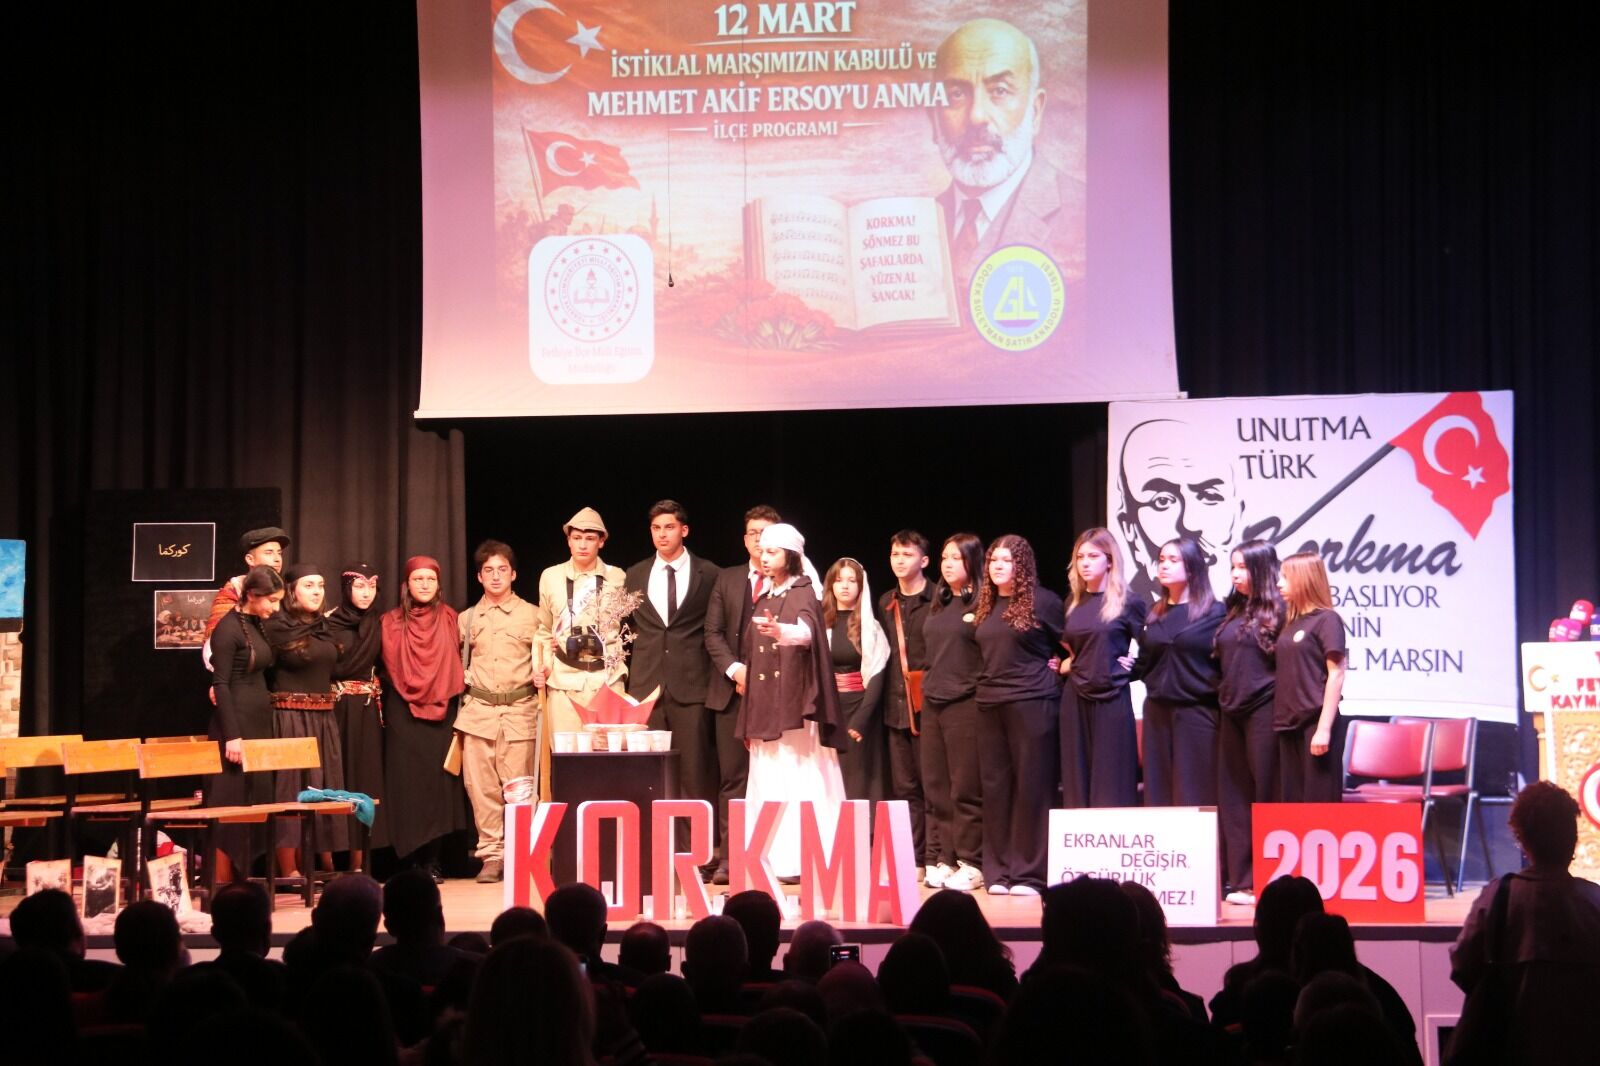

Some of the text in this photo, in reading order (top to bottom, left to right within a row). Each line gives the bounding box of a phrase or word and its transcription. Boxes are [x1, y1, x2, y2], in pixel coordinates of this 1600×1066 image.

[714, 1, 856, 36] 12 MART
[611, 42, 937, 79] İSTİKLAL MARŞIMIZIN KABULÜ VE
[587, 80, 949, 117] MEHMET AKİF ERSOY'U ANMA
[713, 119, 838, 142] İLÇE PROGRAMI
[866, 215, 916, 230] KORKMA!
[862, 233, 920, 250] SÖNMEZ BU
[870, 271, 918, 286] YÜZEN AL
[871, 289, 916, 303] SANCAK!
[1237, 416, 1371, 442] UNUTMA
[1240, 449, 1317, 480] TÜRK
[1328, 585, 1440, 610] BAŞLIYOR
[1365, 648, 1463, 677] MARŞIN
[1551, 694, 1600, 709] KAYM
[1064, 834, 1155, 849] EKRANLAR
[504, 799, 922, 926] KORKMA
[1263, 829, 1419, 903] 2026
